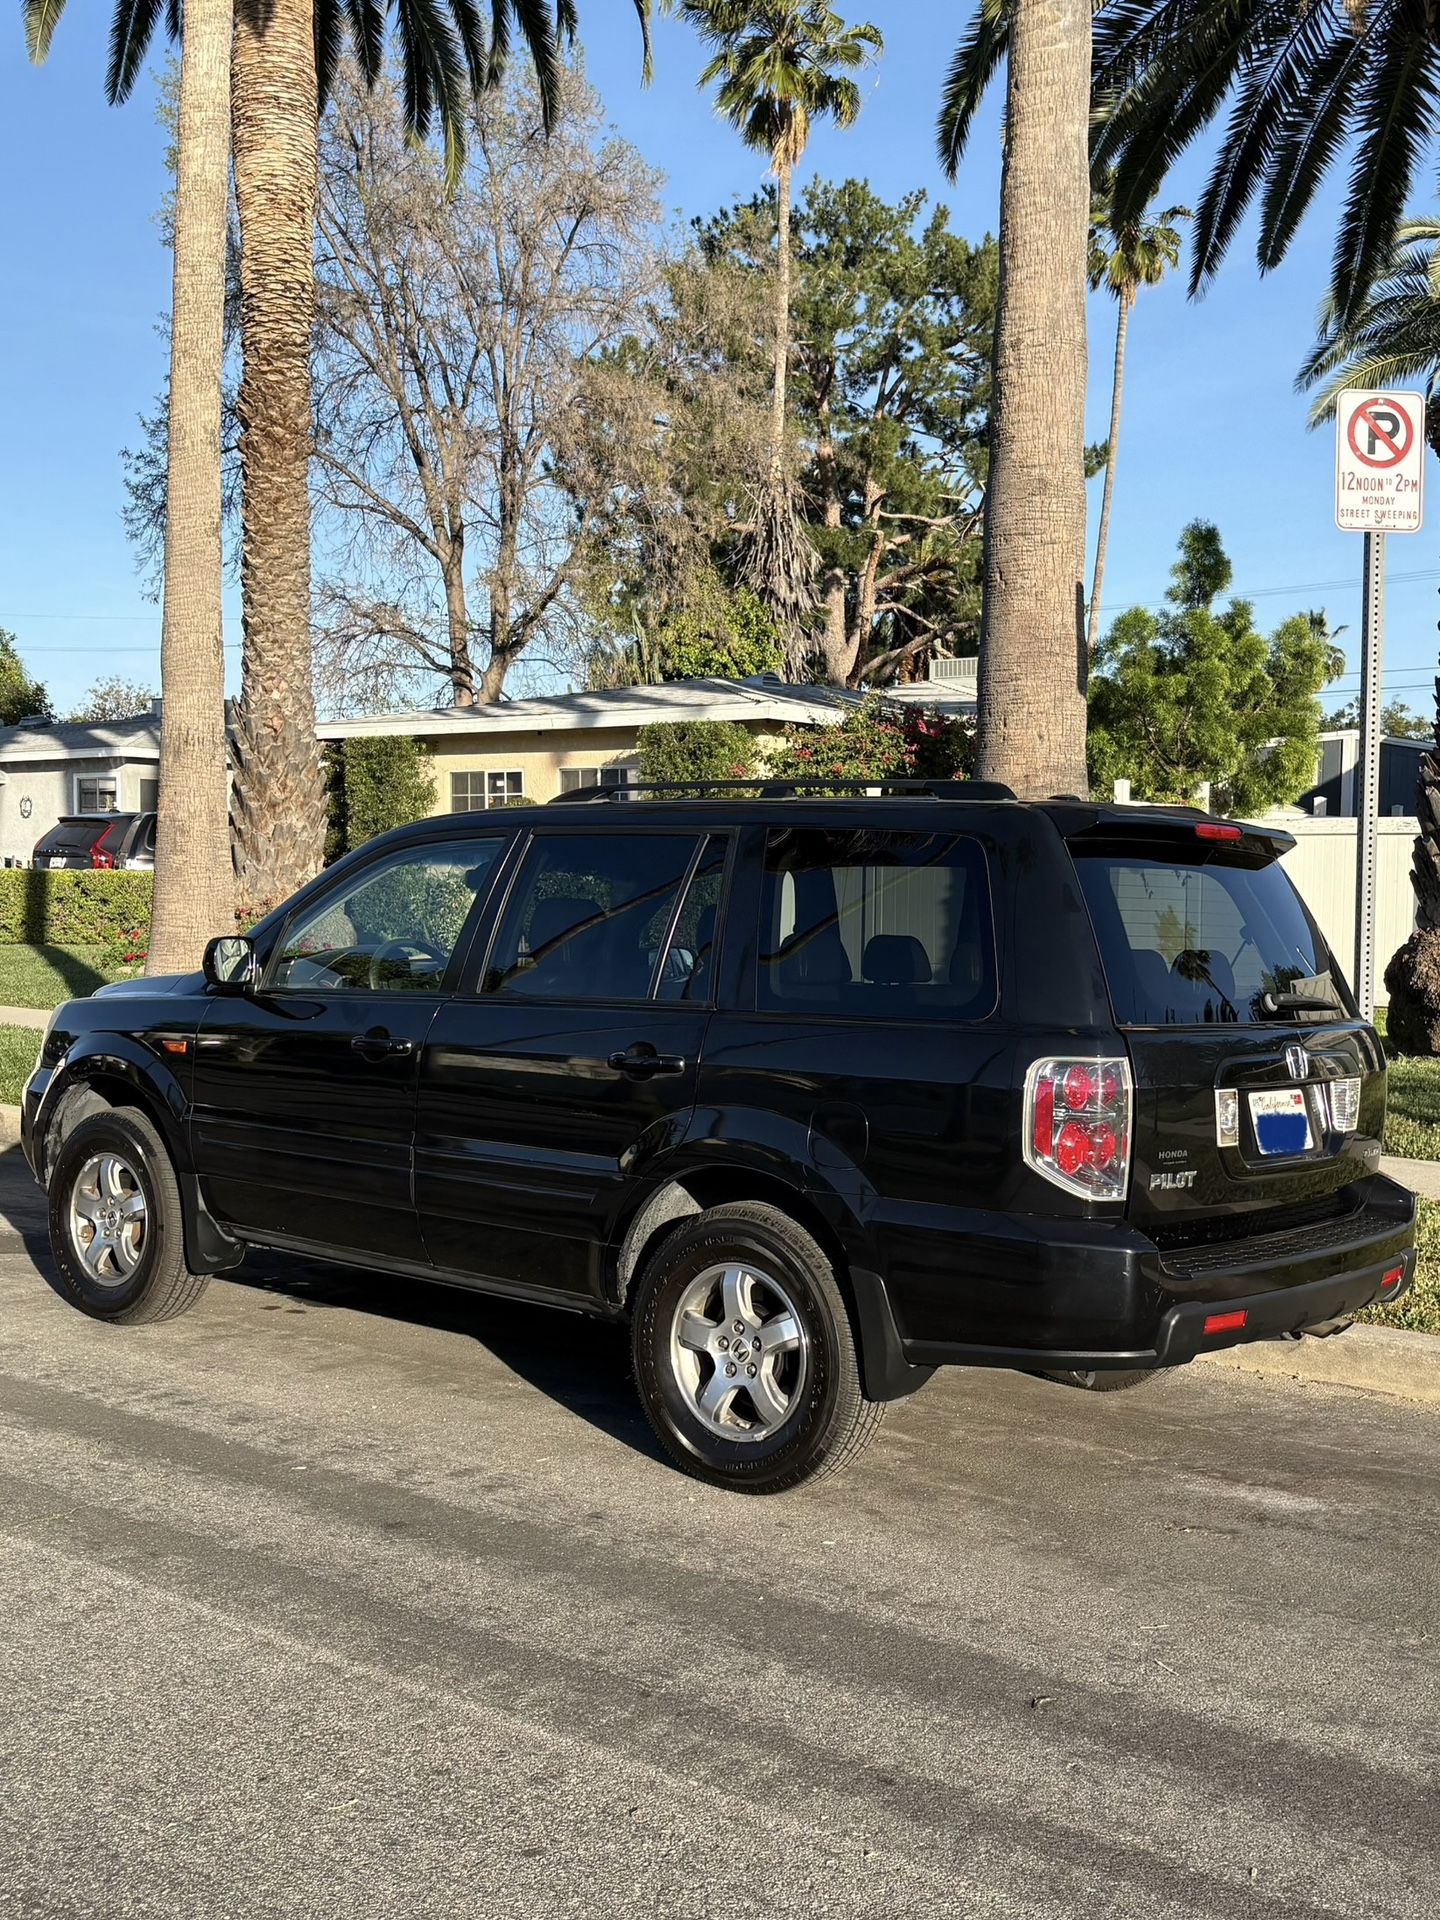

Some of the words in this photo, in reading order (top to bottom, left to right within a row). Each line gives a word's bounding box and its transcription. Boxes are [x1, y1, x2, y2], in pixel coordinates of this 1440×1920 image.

[1367, 411, 1400, 455] P
[1342, 472, 1384, 491] 12NOON
[1395, 473, 1418, 492] 2PM
[1362, 496, 1395, 505] MONDAY
[1340, 508, 1370, 518] STREET
[1374, 509, 1417, 520] SWEEPING
[1158, 1150, 1188, 1159] HONDA
[1149, 1170, 1198, 1191] PILOT
